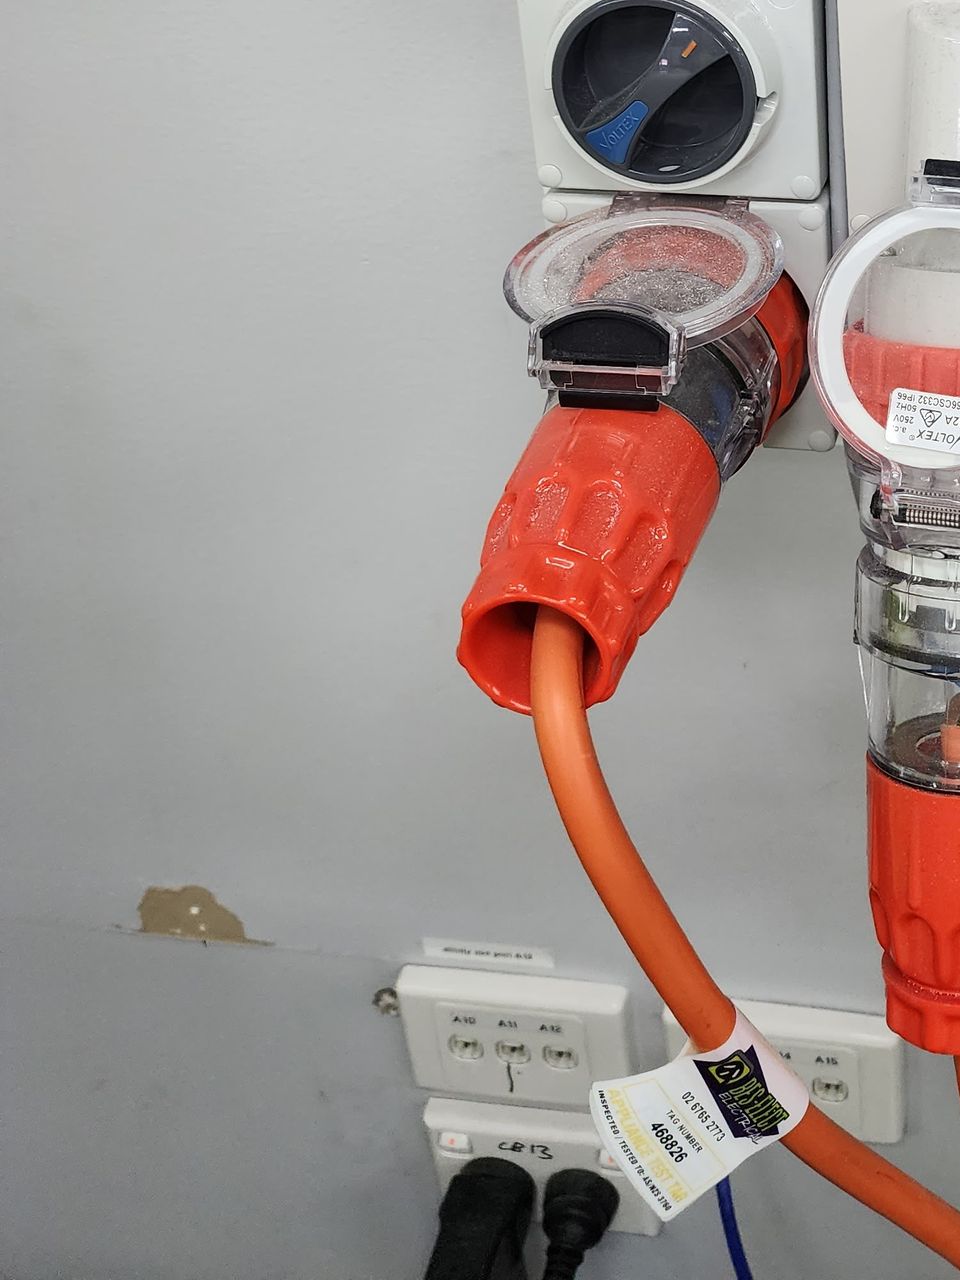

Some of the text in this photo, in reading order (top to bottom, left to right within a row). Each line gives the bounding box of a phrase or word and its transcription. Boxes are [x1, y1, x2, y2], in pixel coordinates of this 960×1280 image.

[600, 111, 640, 150] VOLTEX
[896, 402, 917, 412] 50Hz
[897, 392, 916, 401] IP66
[893, 414, 914, 424] 250V
[452, 1015, 476, 1025] A10
[498, 1020, 518, 1029] A11
[598, 1090, 620, 1136] INSPECTED
[619, 1140, 638, 1165] TESTED
[666, 1109, 704, 1154] TAG NUMBER
[681, 1091, 726, 1142] 02 6765 2773
[719, 1091, 762, 1145] ELECTRICAL
[651, 1123, 688, 1163] 468826
